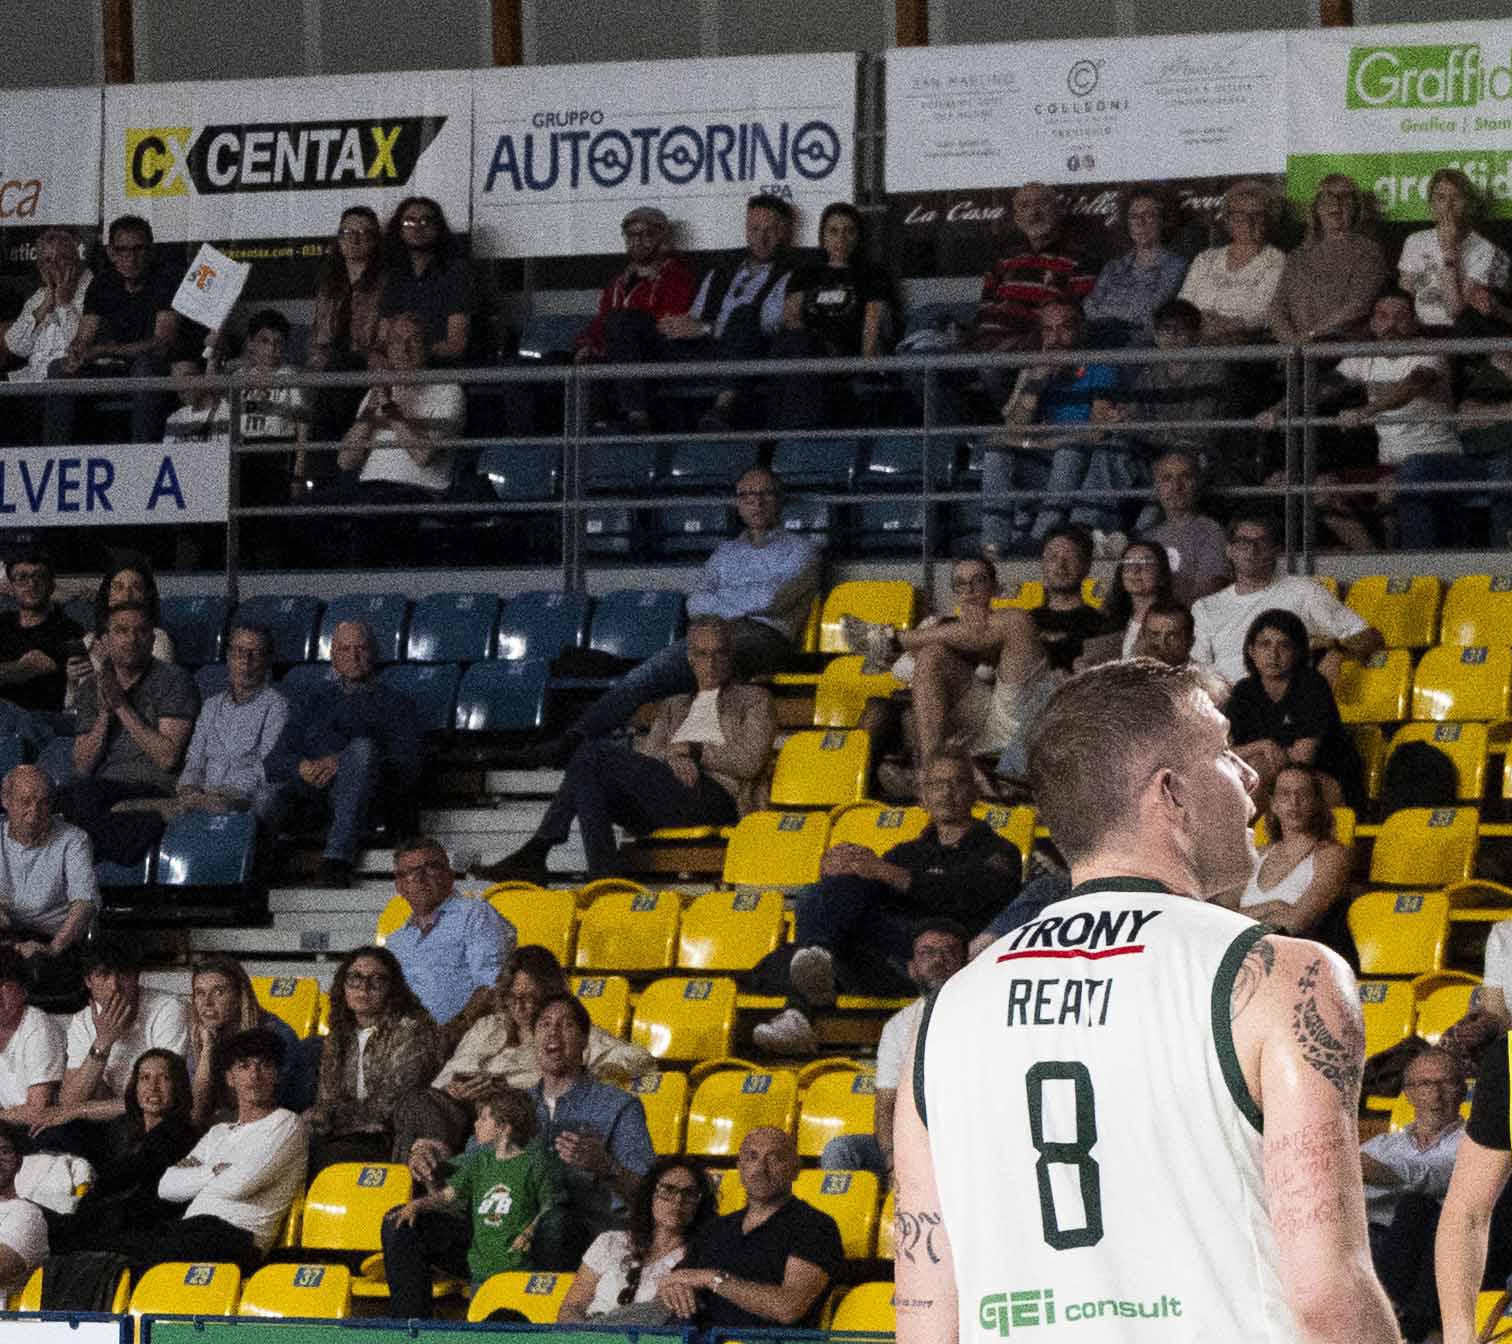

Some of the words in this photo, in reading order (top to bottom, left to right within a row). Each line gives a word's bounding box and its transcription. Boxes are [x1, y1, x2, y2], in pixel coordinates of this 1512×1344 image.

[532, 109, 605, 129] GRUPPO
[1401, 116, 1456, 134] Grafica
[205, 124, 404, 187] CENTAX
[483, 119, 842, 195] AUTOTORINO
[904, 203, 938, 225] La
[946, 199, 1006, 222] Casa
[146, 455, 187, 511] A
[1008, 909, 1162, 951] TRONY
[1006, 978, 1114, 1028] REATI
[1025, 1060, 1104, 1252] 8
[1065, 1294, 1184, 1324] consult
